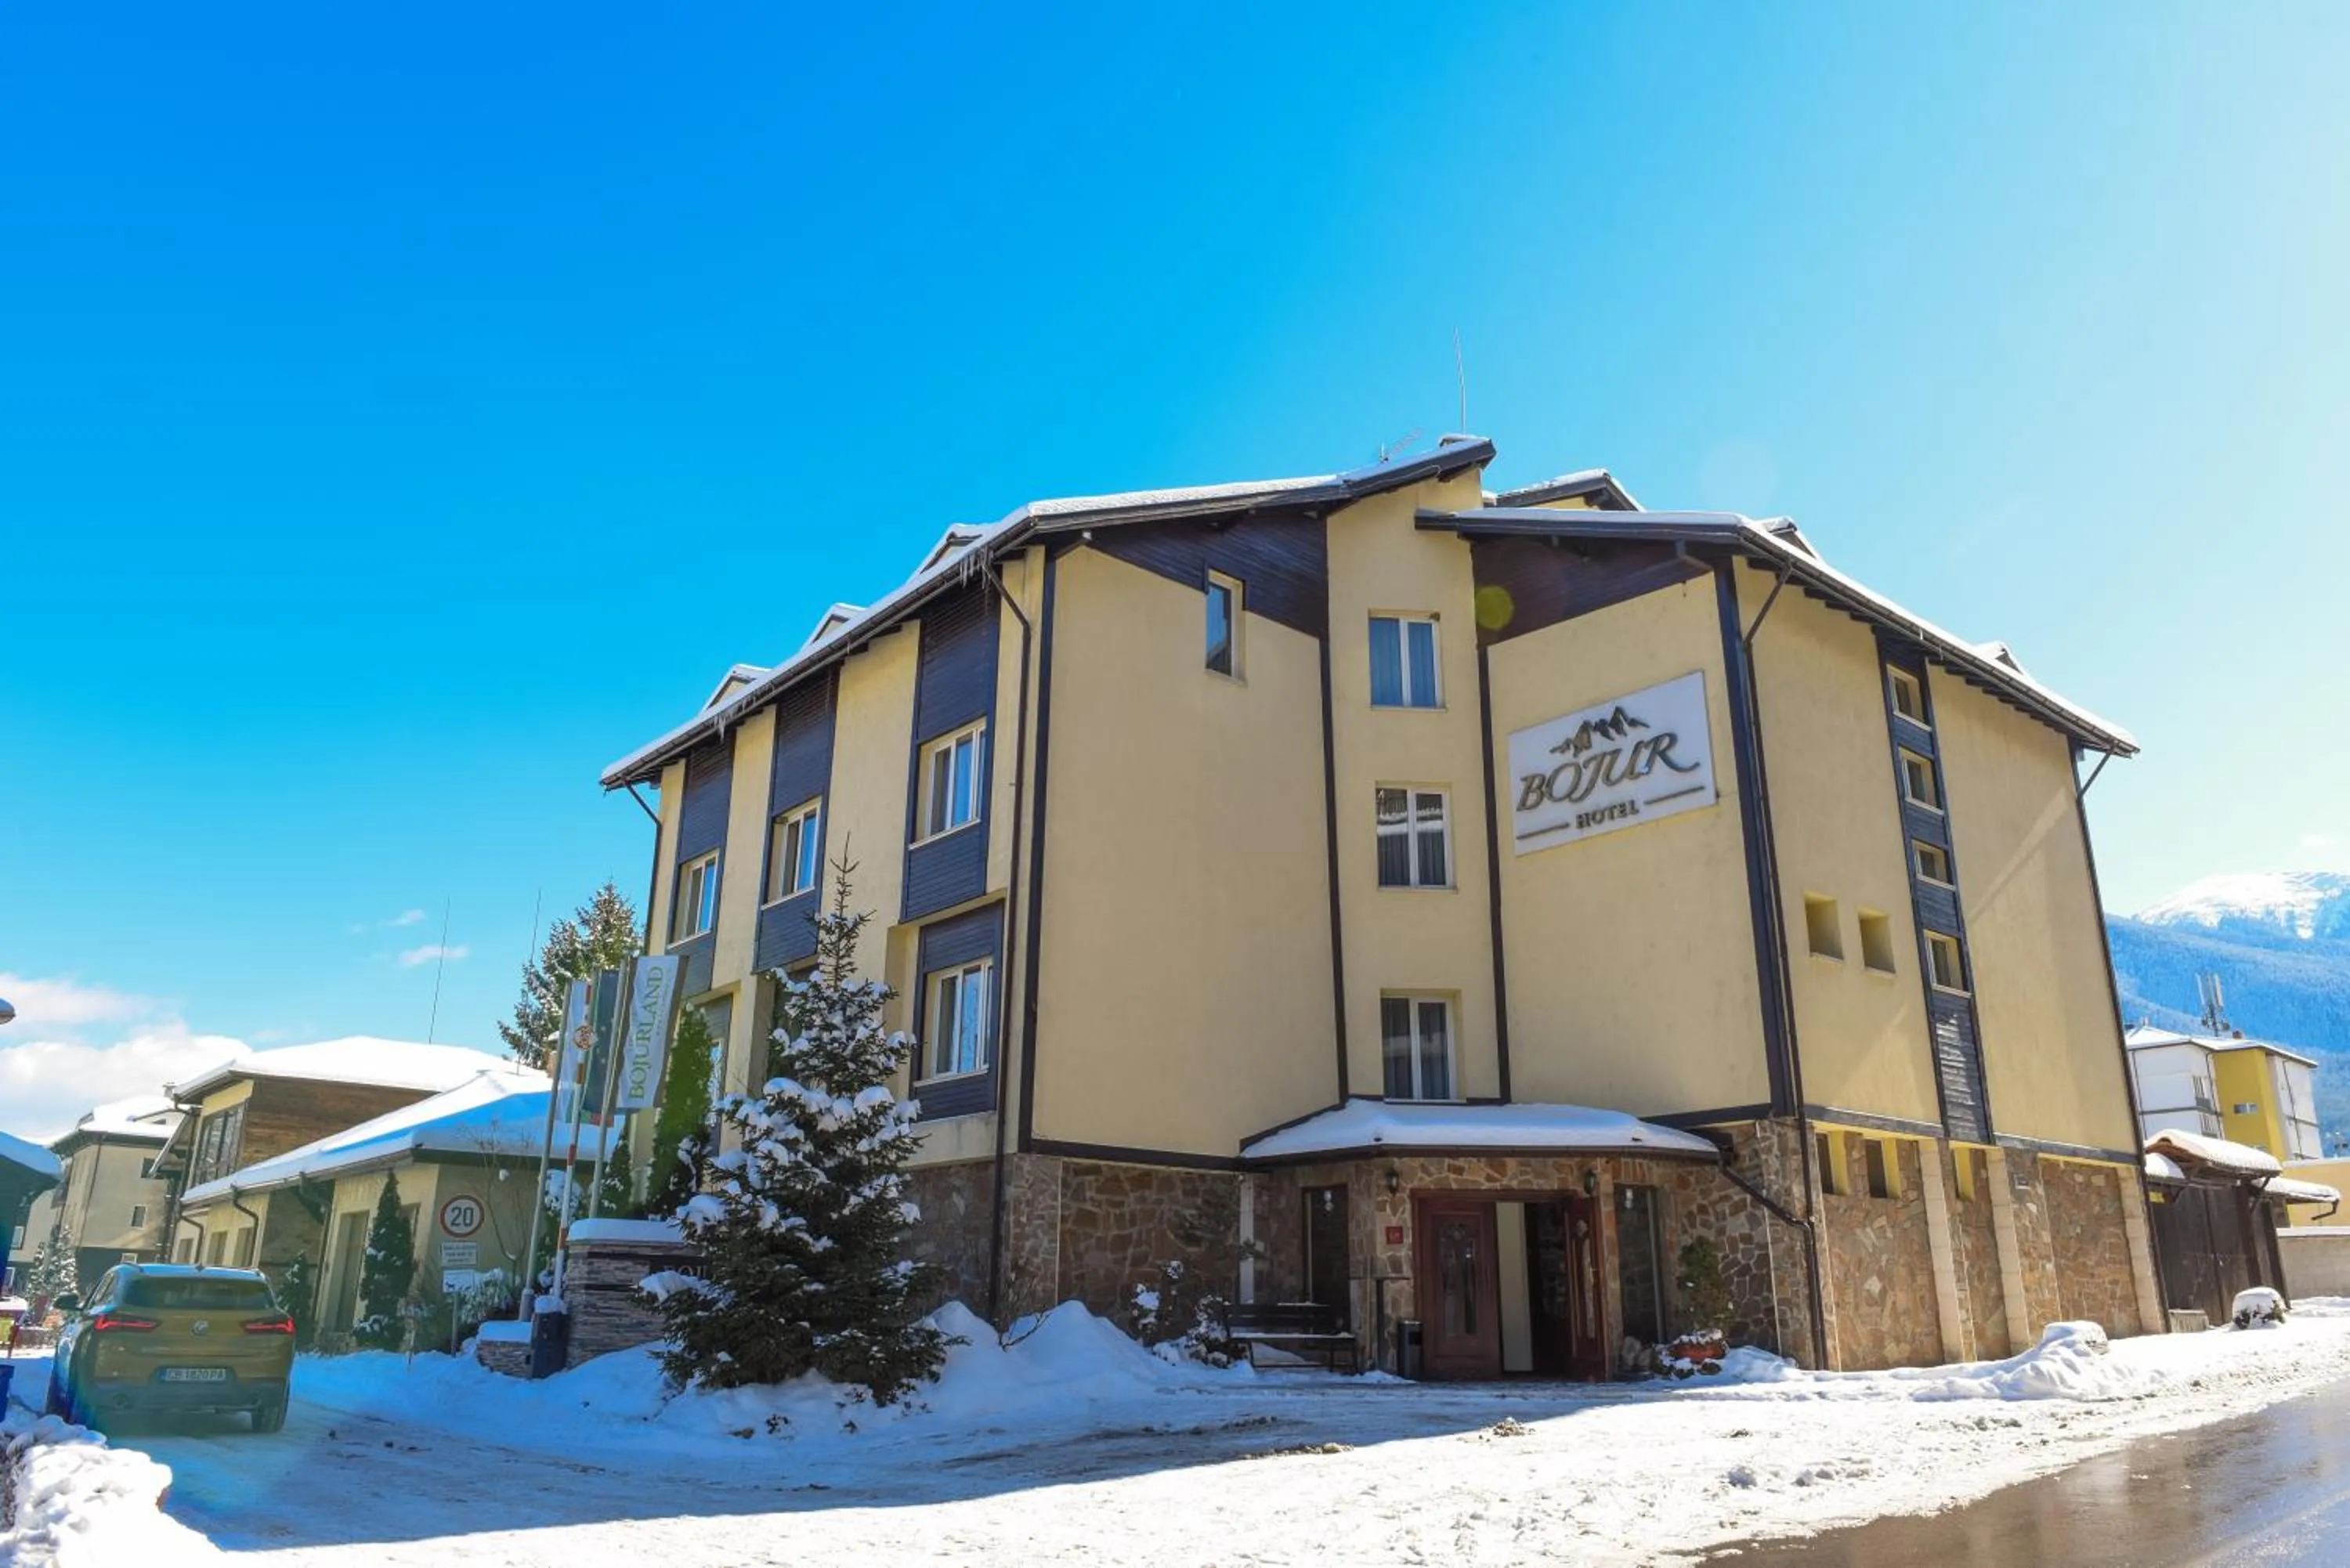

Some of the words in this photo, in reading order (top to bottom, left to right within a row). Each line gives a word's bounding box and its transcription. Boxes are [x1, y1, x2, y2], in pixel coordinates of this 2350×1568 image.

[1516, 732, 1701, 811] BOJUR
[1575, 800, 1640, 829] HOTEL
[629, 966, 664, 1099] BOJURLAND
[450, 1207, 474, 1227] 20
